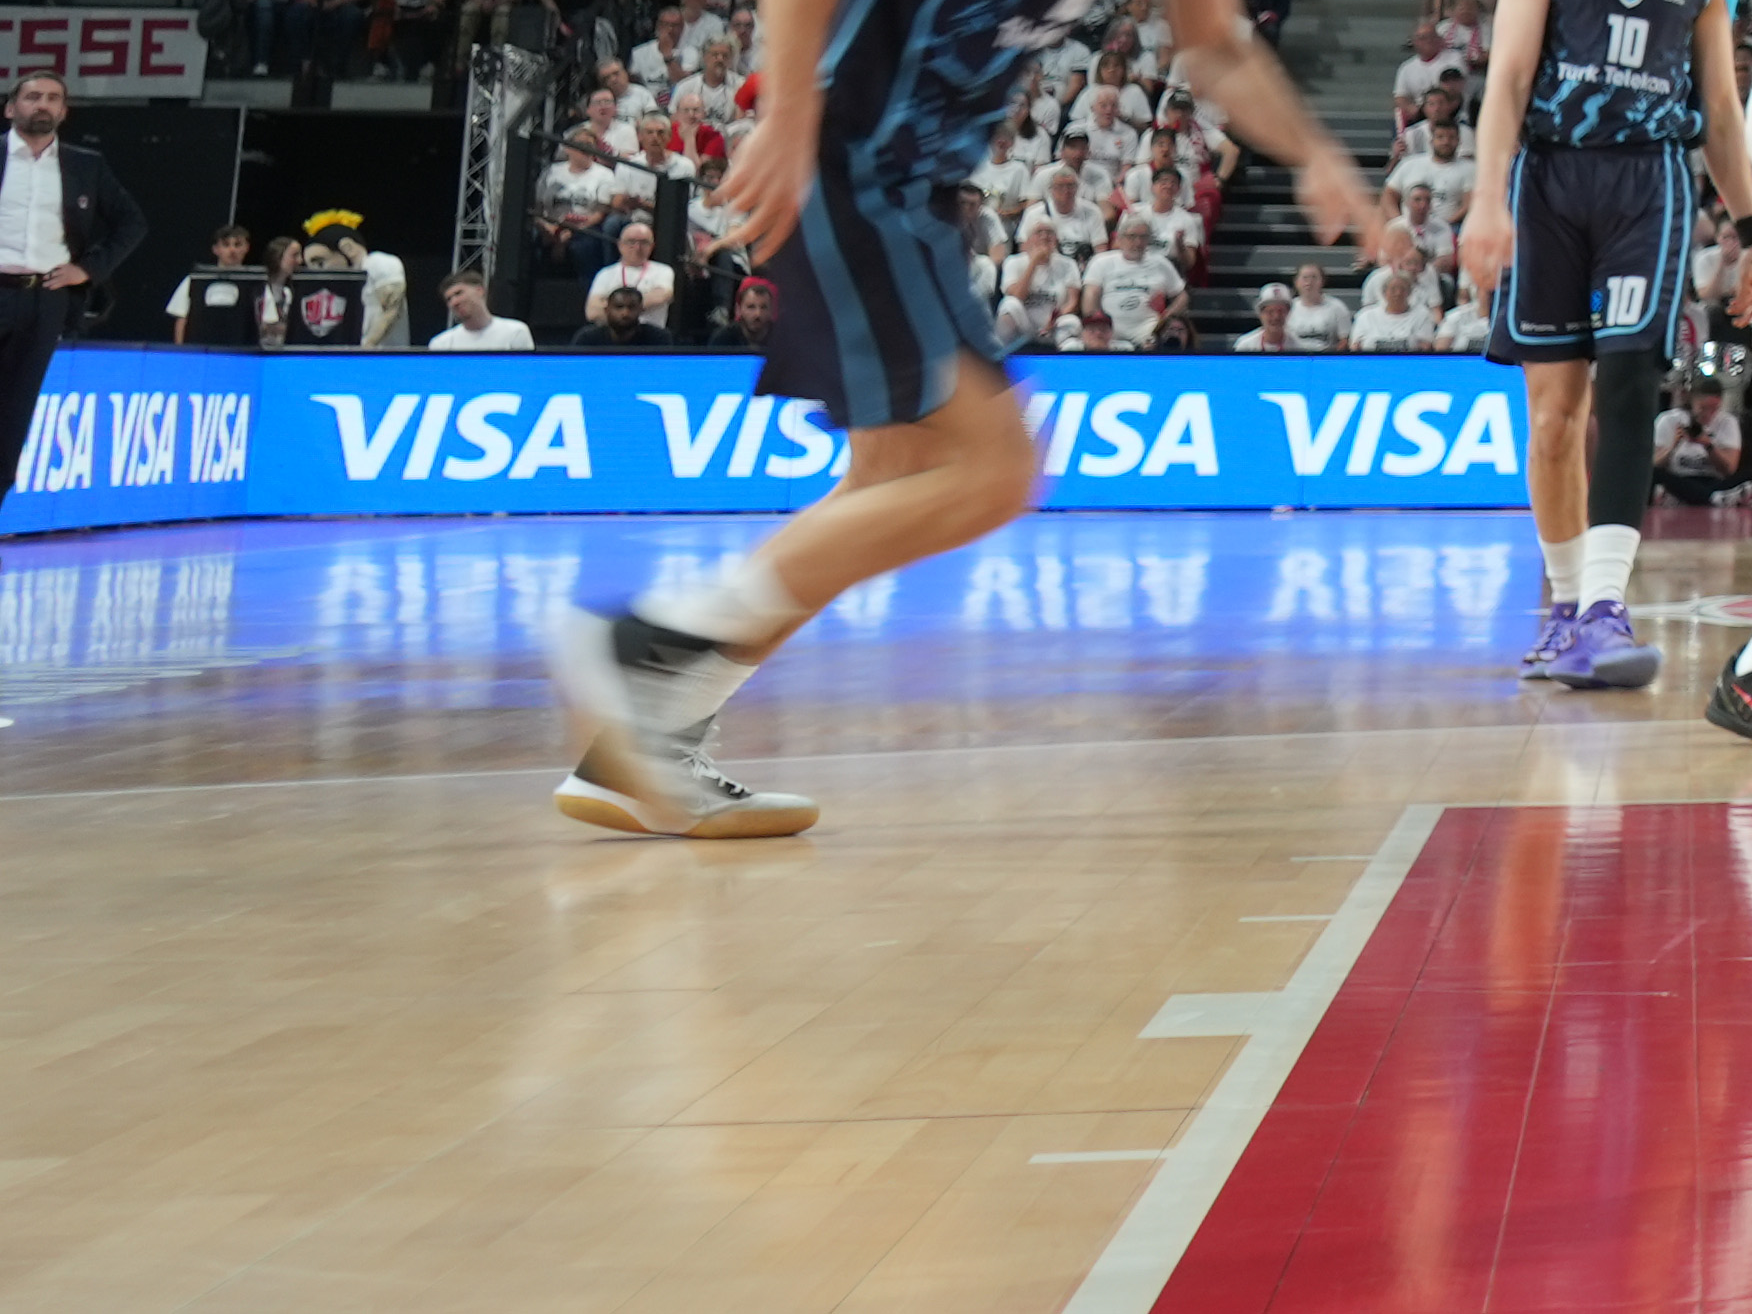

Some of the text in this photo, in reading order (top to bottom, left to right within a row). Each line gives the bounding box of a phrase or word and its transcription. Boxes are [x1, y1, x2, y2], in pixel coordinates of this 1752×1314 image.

[0, 19, 189, 76] SSE
[1606, 12, 1650, 69] 10
[1606, 275, 1648, 327] 10
[108, 392, 177, 486] VISA
[189, 392, 251, 483] VISA
[310, 393, 593, 481] VISA
[636, 393, 848, 479] VIS
[1258, 392, 1518, 479] VISA
